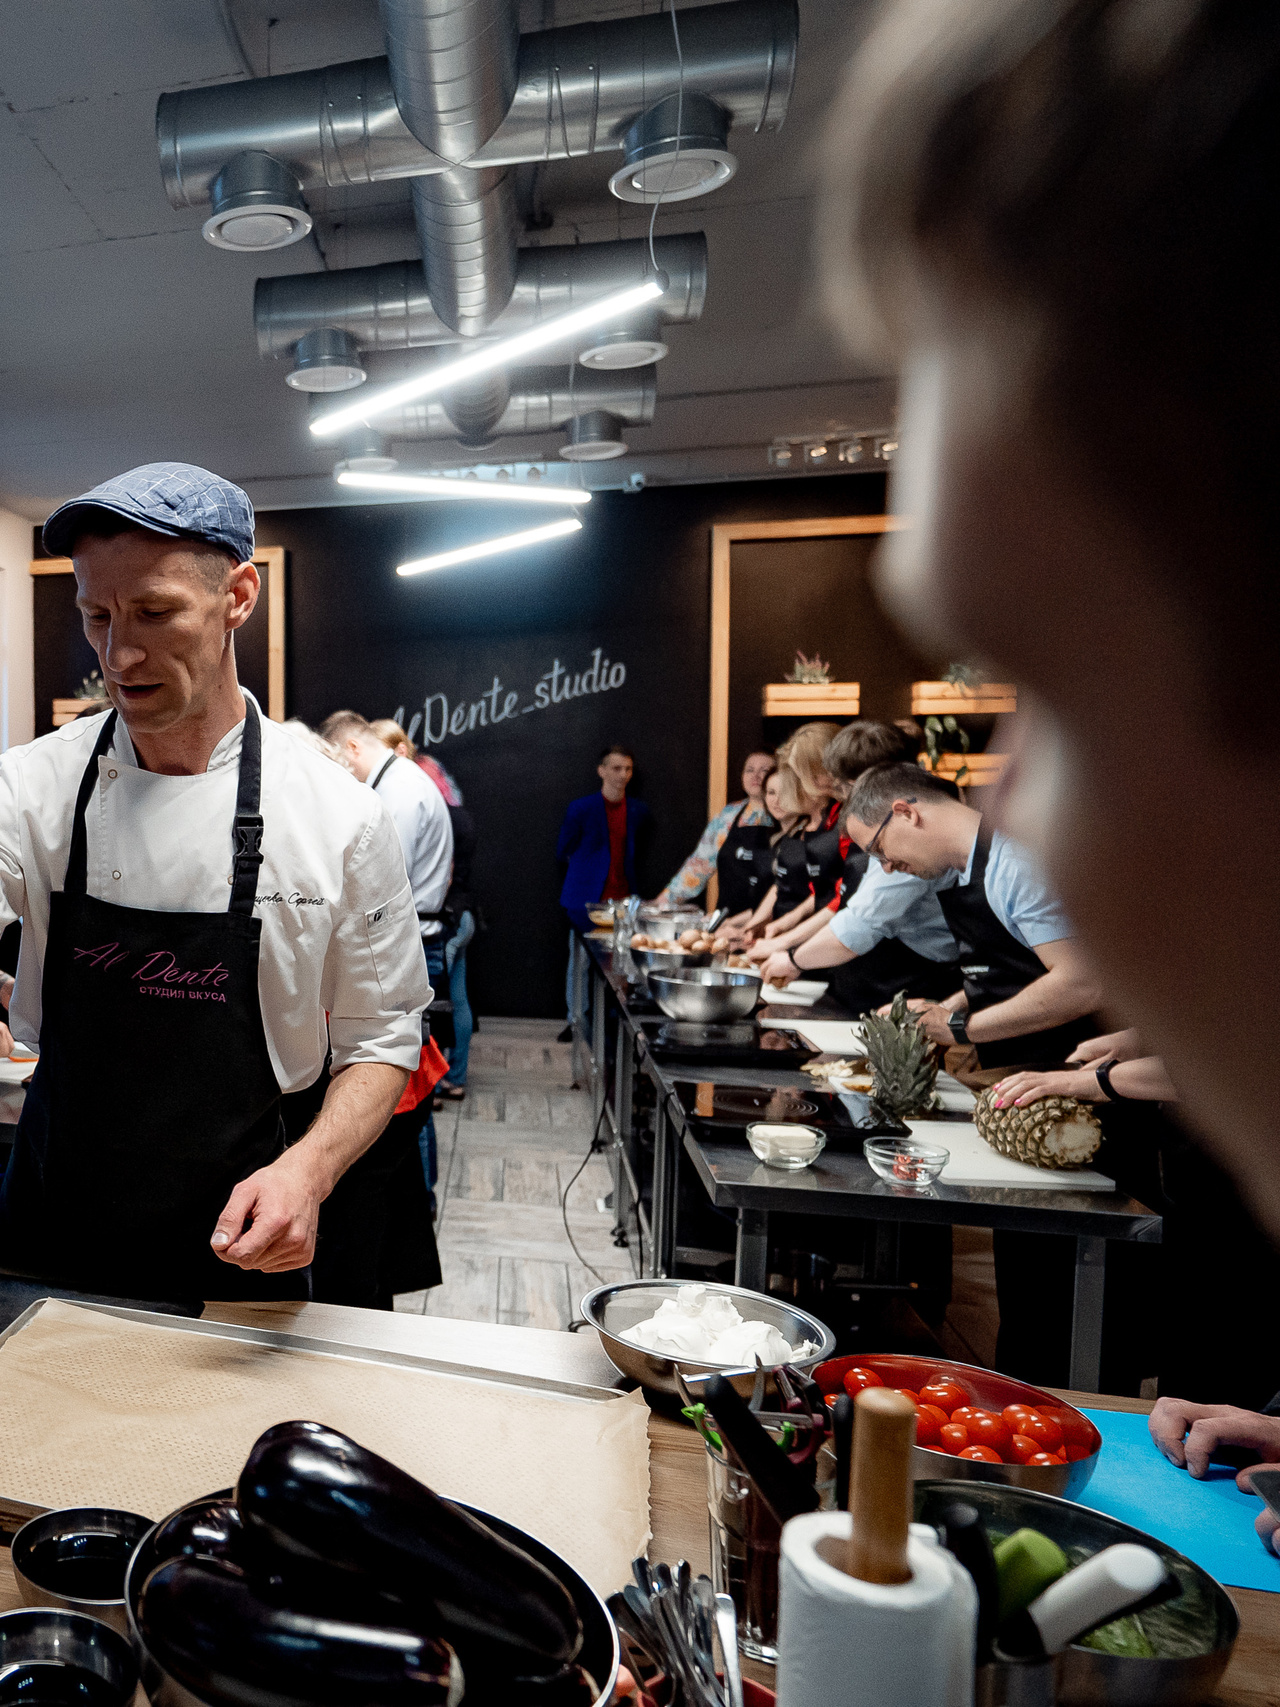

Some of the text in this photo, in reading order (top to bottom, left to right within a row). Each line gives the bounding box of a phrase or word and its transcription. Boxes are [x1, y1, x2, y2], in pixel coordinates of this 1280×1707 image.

[74, 942, 229, 987] Al Dente
[139, 986, 227, 1003] СТУДИЯ ВКУСА
